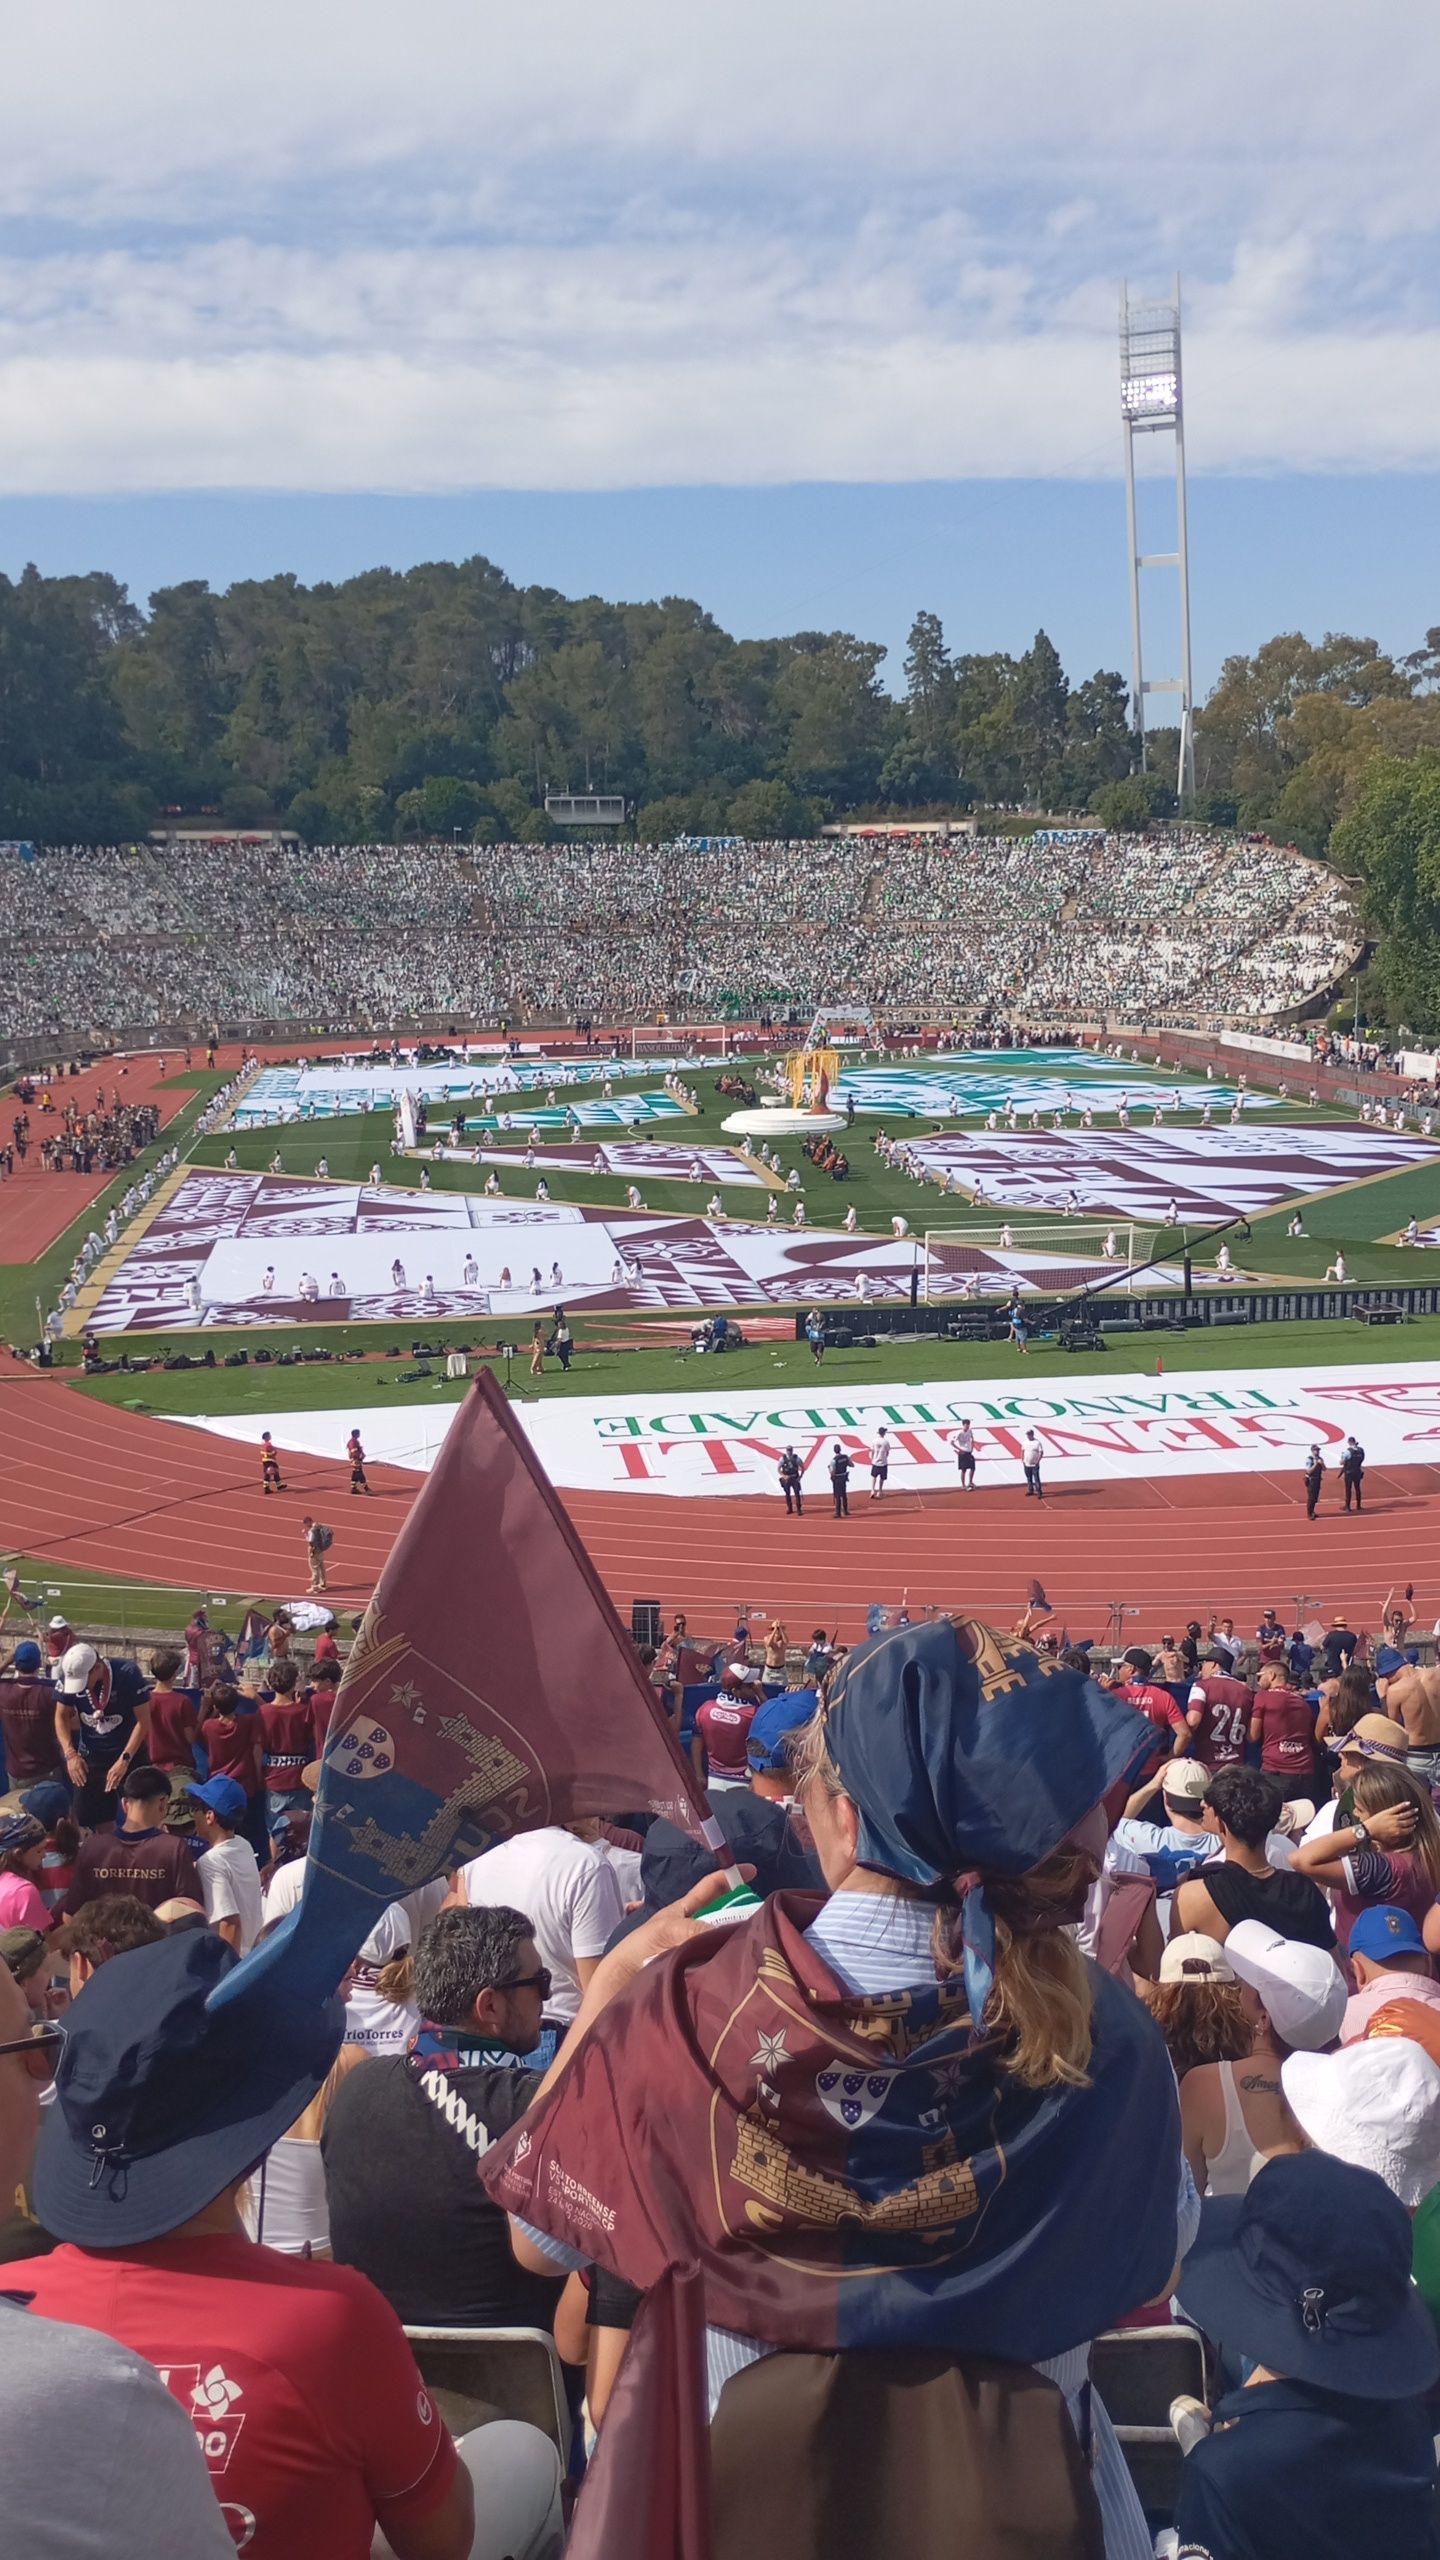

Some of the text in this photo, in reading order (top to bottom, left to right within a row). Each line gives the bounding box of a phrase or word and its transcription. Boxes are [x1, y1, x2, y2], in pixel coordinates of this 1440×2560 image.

[594, 1389, 1300, 1437] TRANQUILIDADE
[602, 1413, 1345, 1480] GENERALI
[1210, 1703, 1246, 1745] 26
[93, 1867, 166, 1879] TORREENSE
[344, 2029, 403, 2041] rioTorres
[601, 2218, 616, 2231] CP
